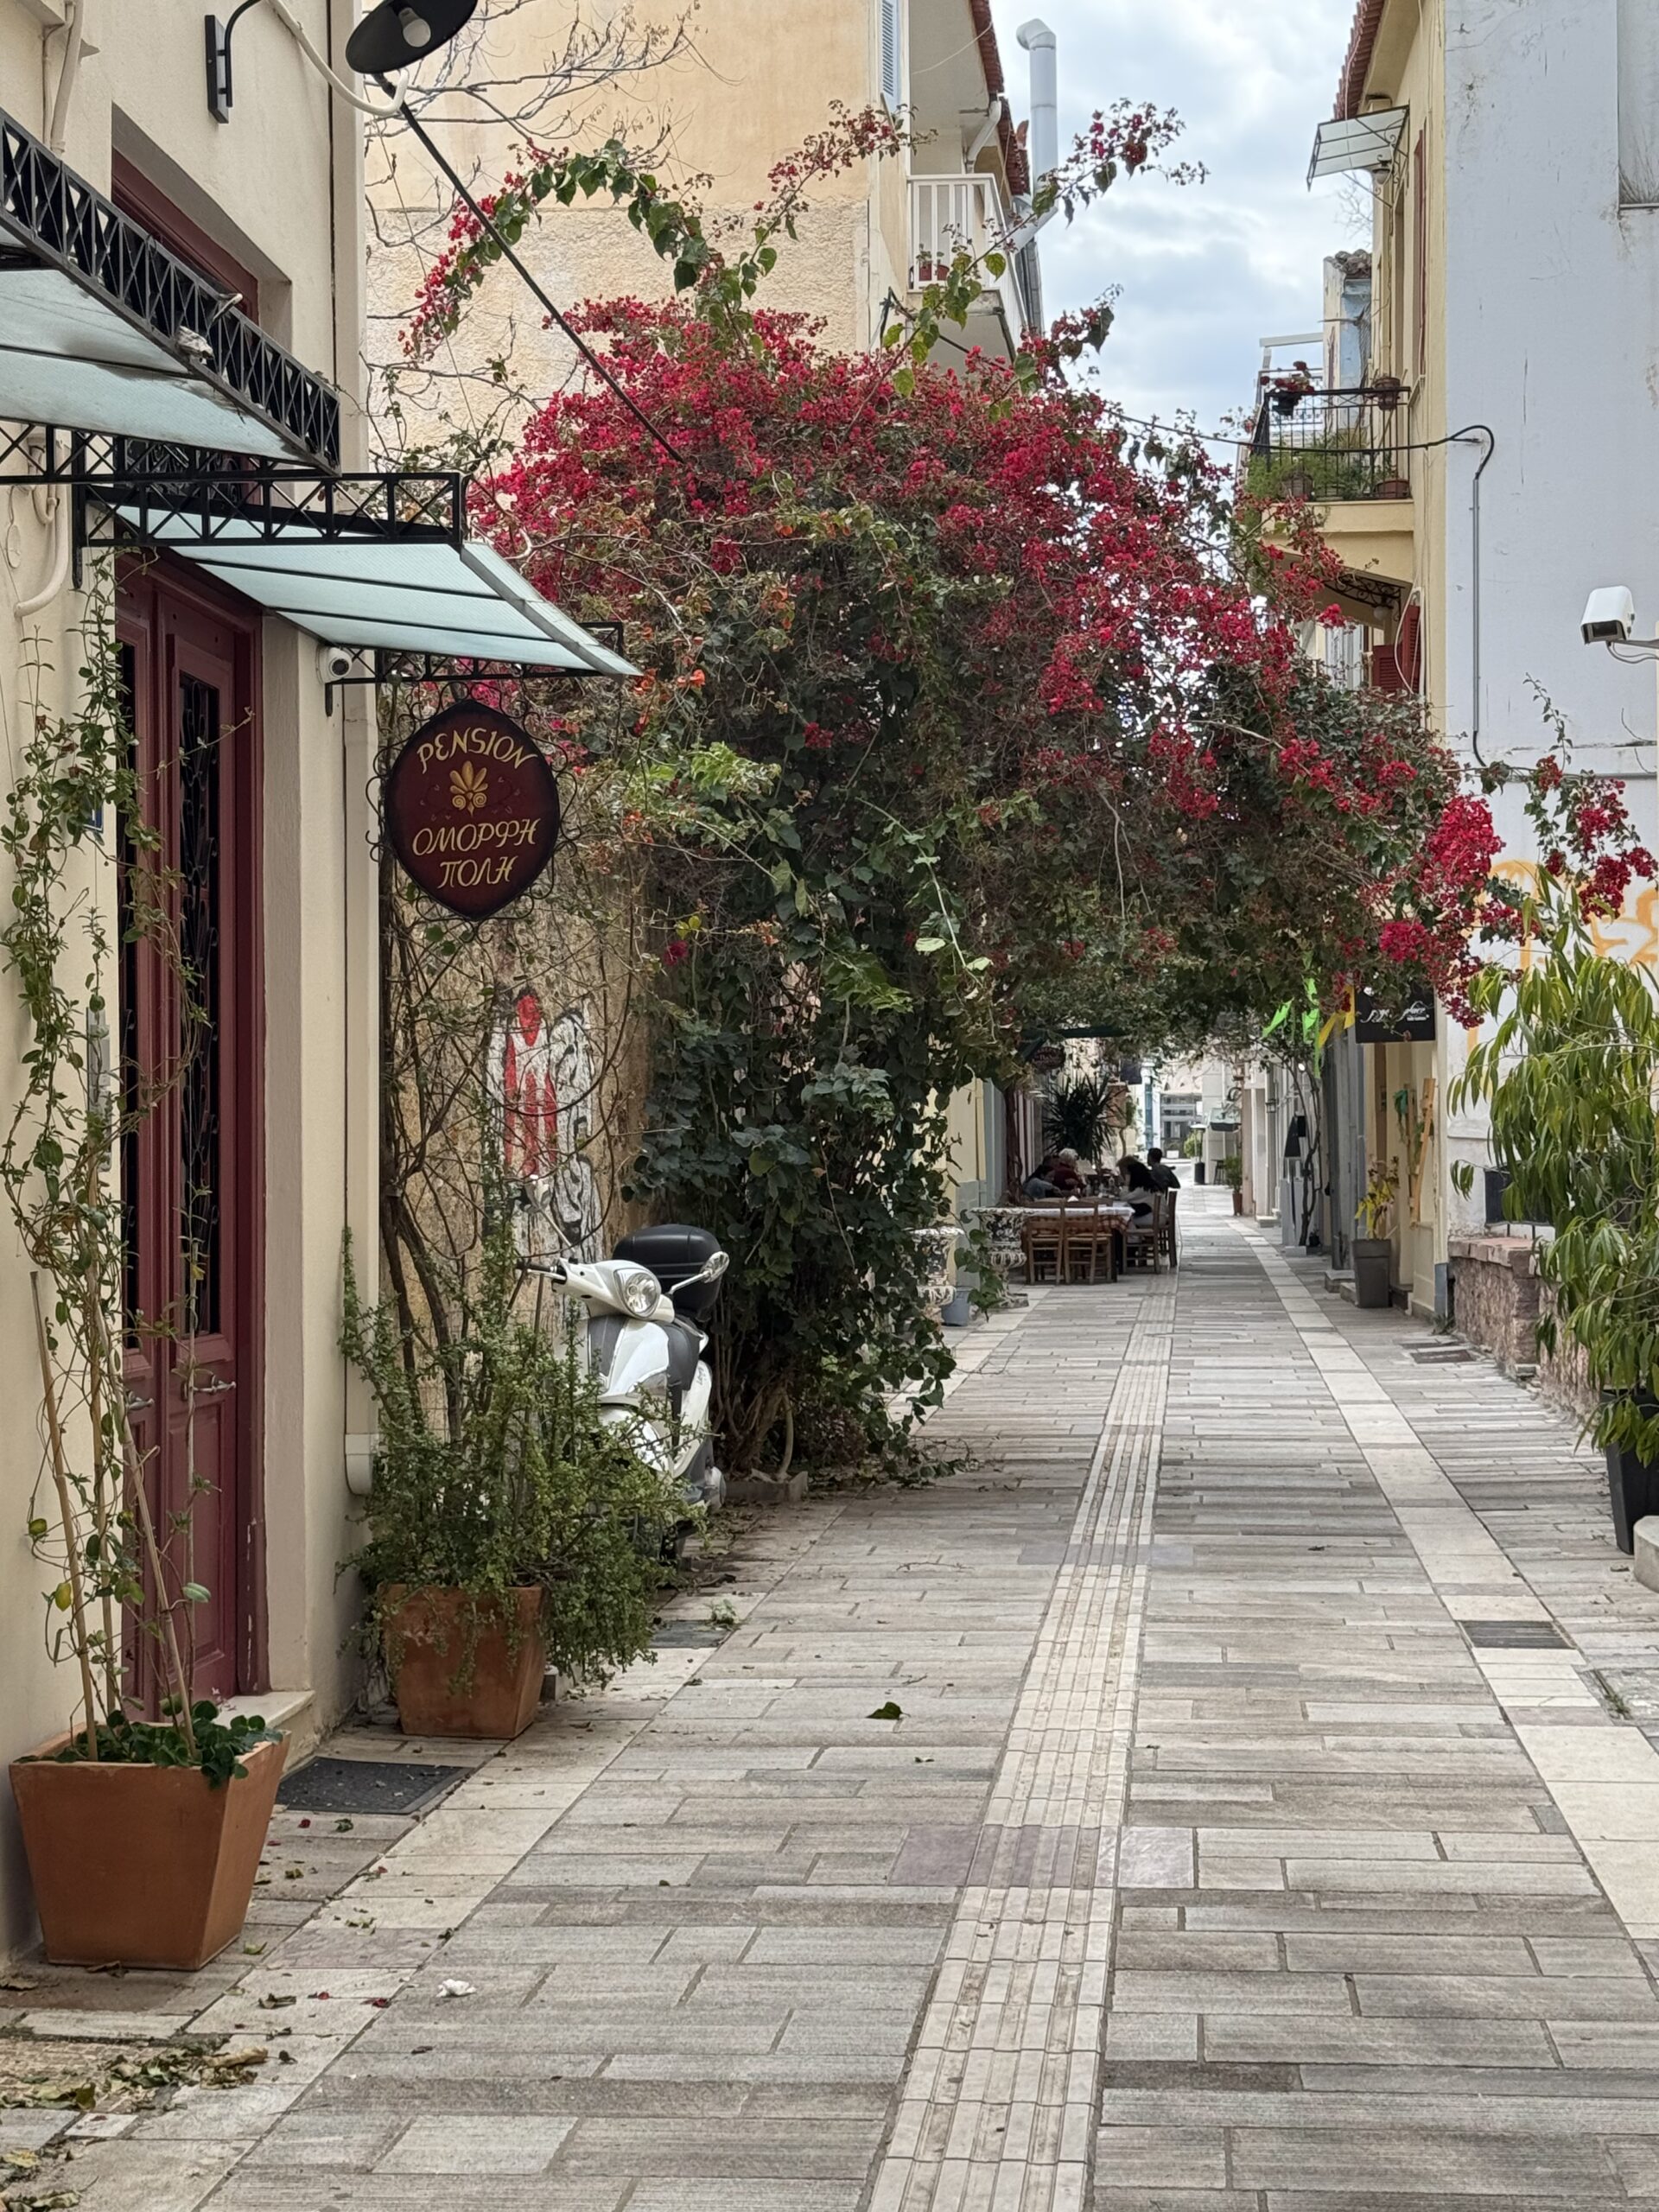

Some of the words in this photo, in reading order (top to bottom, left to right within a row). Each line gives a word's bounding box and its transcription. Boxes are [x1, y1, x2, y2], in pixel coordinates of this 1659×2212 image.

[416, 727, 537, 774] PENSION
[413, 818, 541, 856] ΟΜΟΡΦΗ
[438, 856, 518, 888] ΠΟΛΗ
